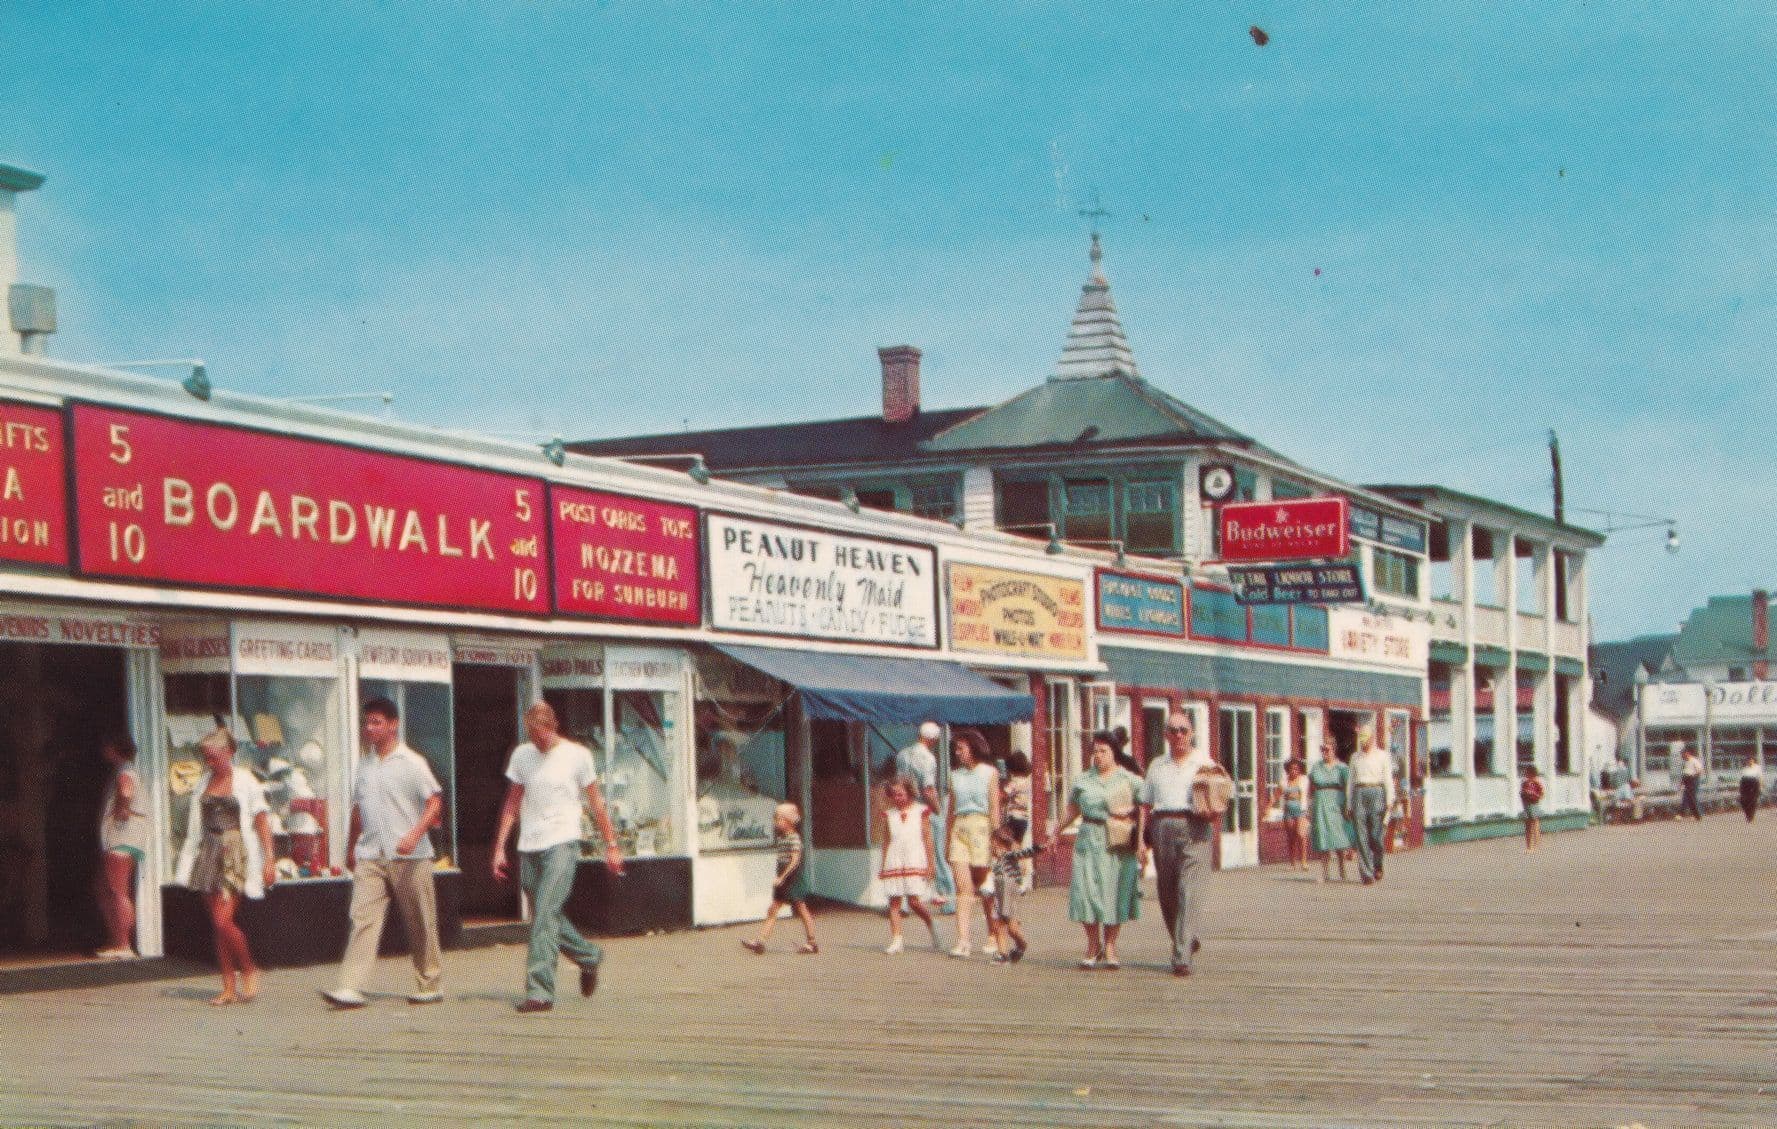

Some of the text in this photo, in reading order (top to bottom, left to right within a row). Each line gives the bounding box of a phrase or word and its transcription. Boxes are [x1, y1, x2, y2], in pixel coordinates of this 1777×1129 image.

[108, 424, 132, 464] 5
[103, 483, 143, 511] and
[514, 489, 533, 522] 5
[163, 476, 496, 561] BOARDWALK
[559, 500, 694, 540] POST CARDS TOYS
[1227, 518, 1337, 542] Budweiser
[109, 521, 146, 563] 10
[510, 534, 538, 558] and
[723, 526, 922, 577] PEANUT HEAVEN
[580, 542, 679, 581] NOXZEMA
[1318, 567, 1356, 585] STORE
[513, 567, 538, 602] 10
[572, 576, 689, 611] FOR SUNBURN
[742, 561, 846, 613] Heavenly
[856, 573, 905, 610] Maid
[59, 617, 161, 646] NOVELTIES
[238, 638, 333, 663] GREETING CARDS
[1711, 684, 1777, 706] Doll
